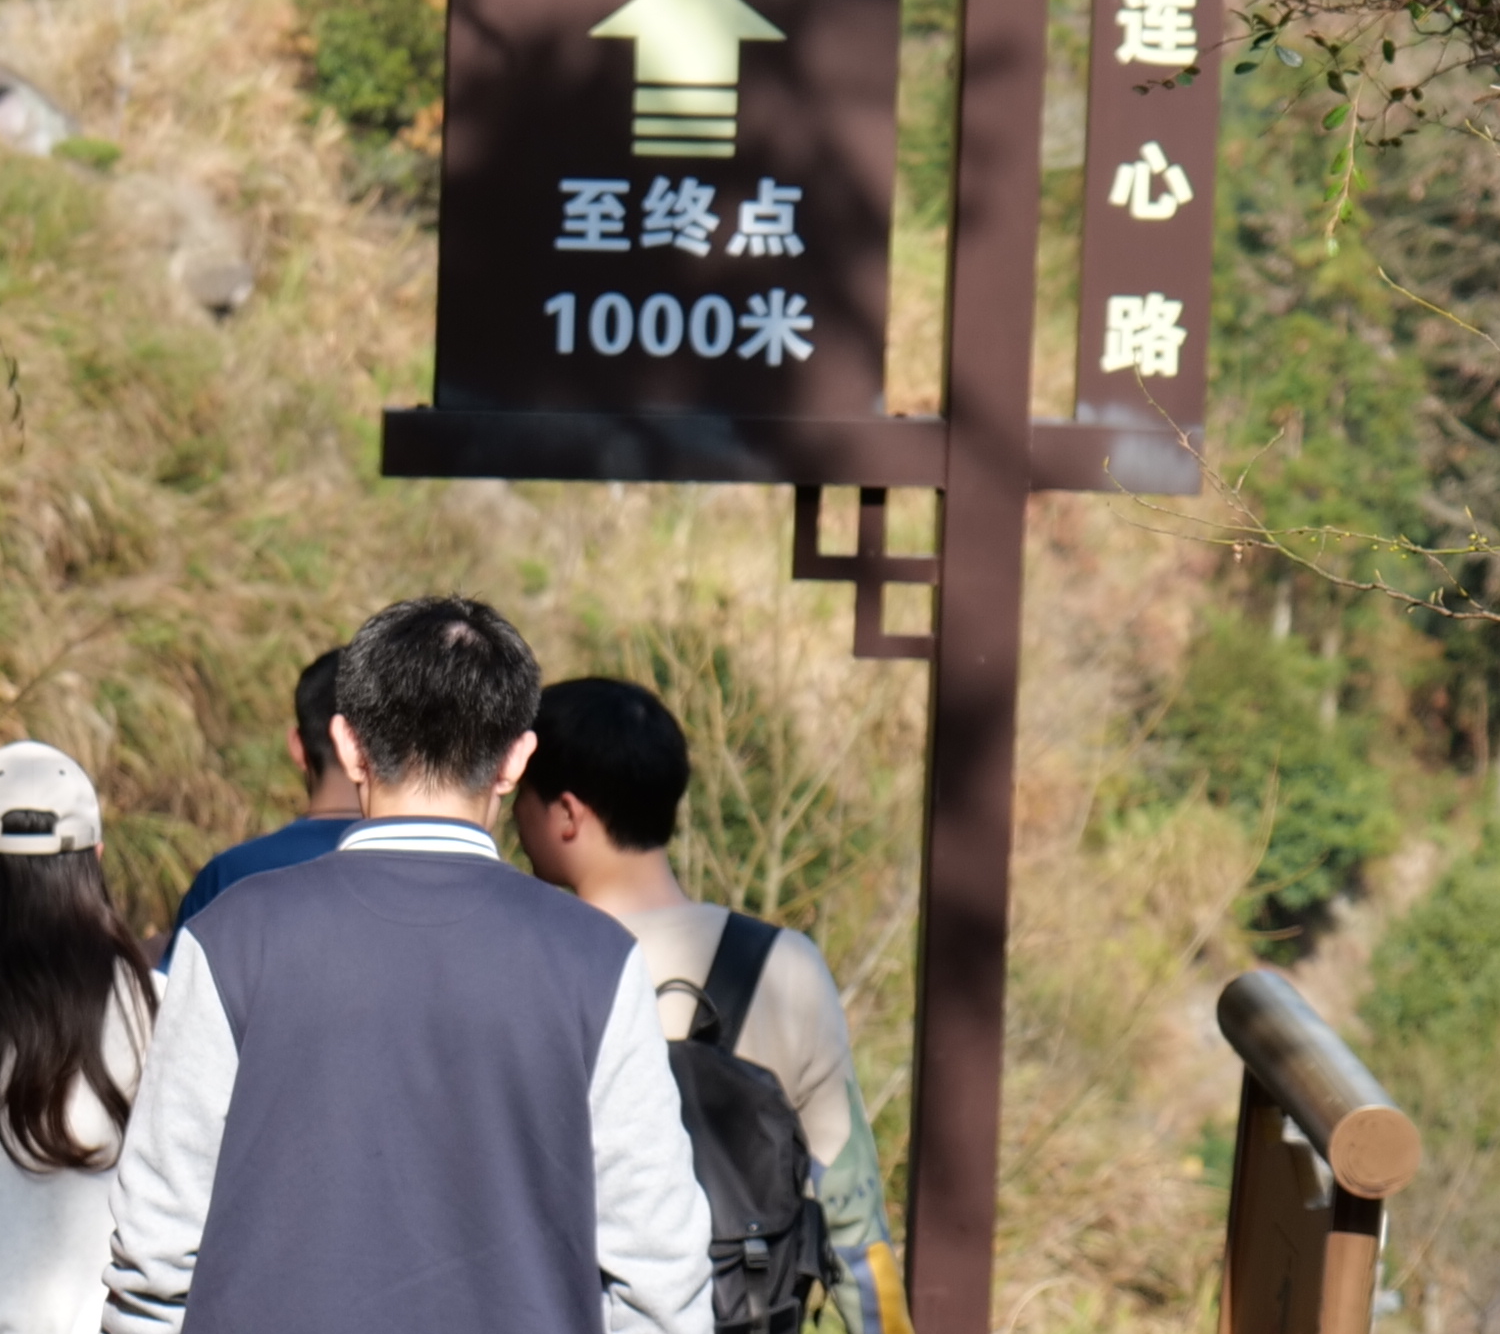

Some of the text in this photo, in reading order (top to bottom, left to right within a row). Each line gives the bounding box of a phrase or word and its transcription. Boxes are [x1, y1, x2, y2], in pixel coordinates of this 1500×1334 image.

[554, 175, 805, 258] 至终点
[543, 287, 815, 367] 1000米
